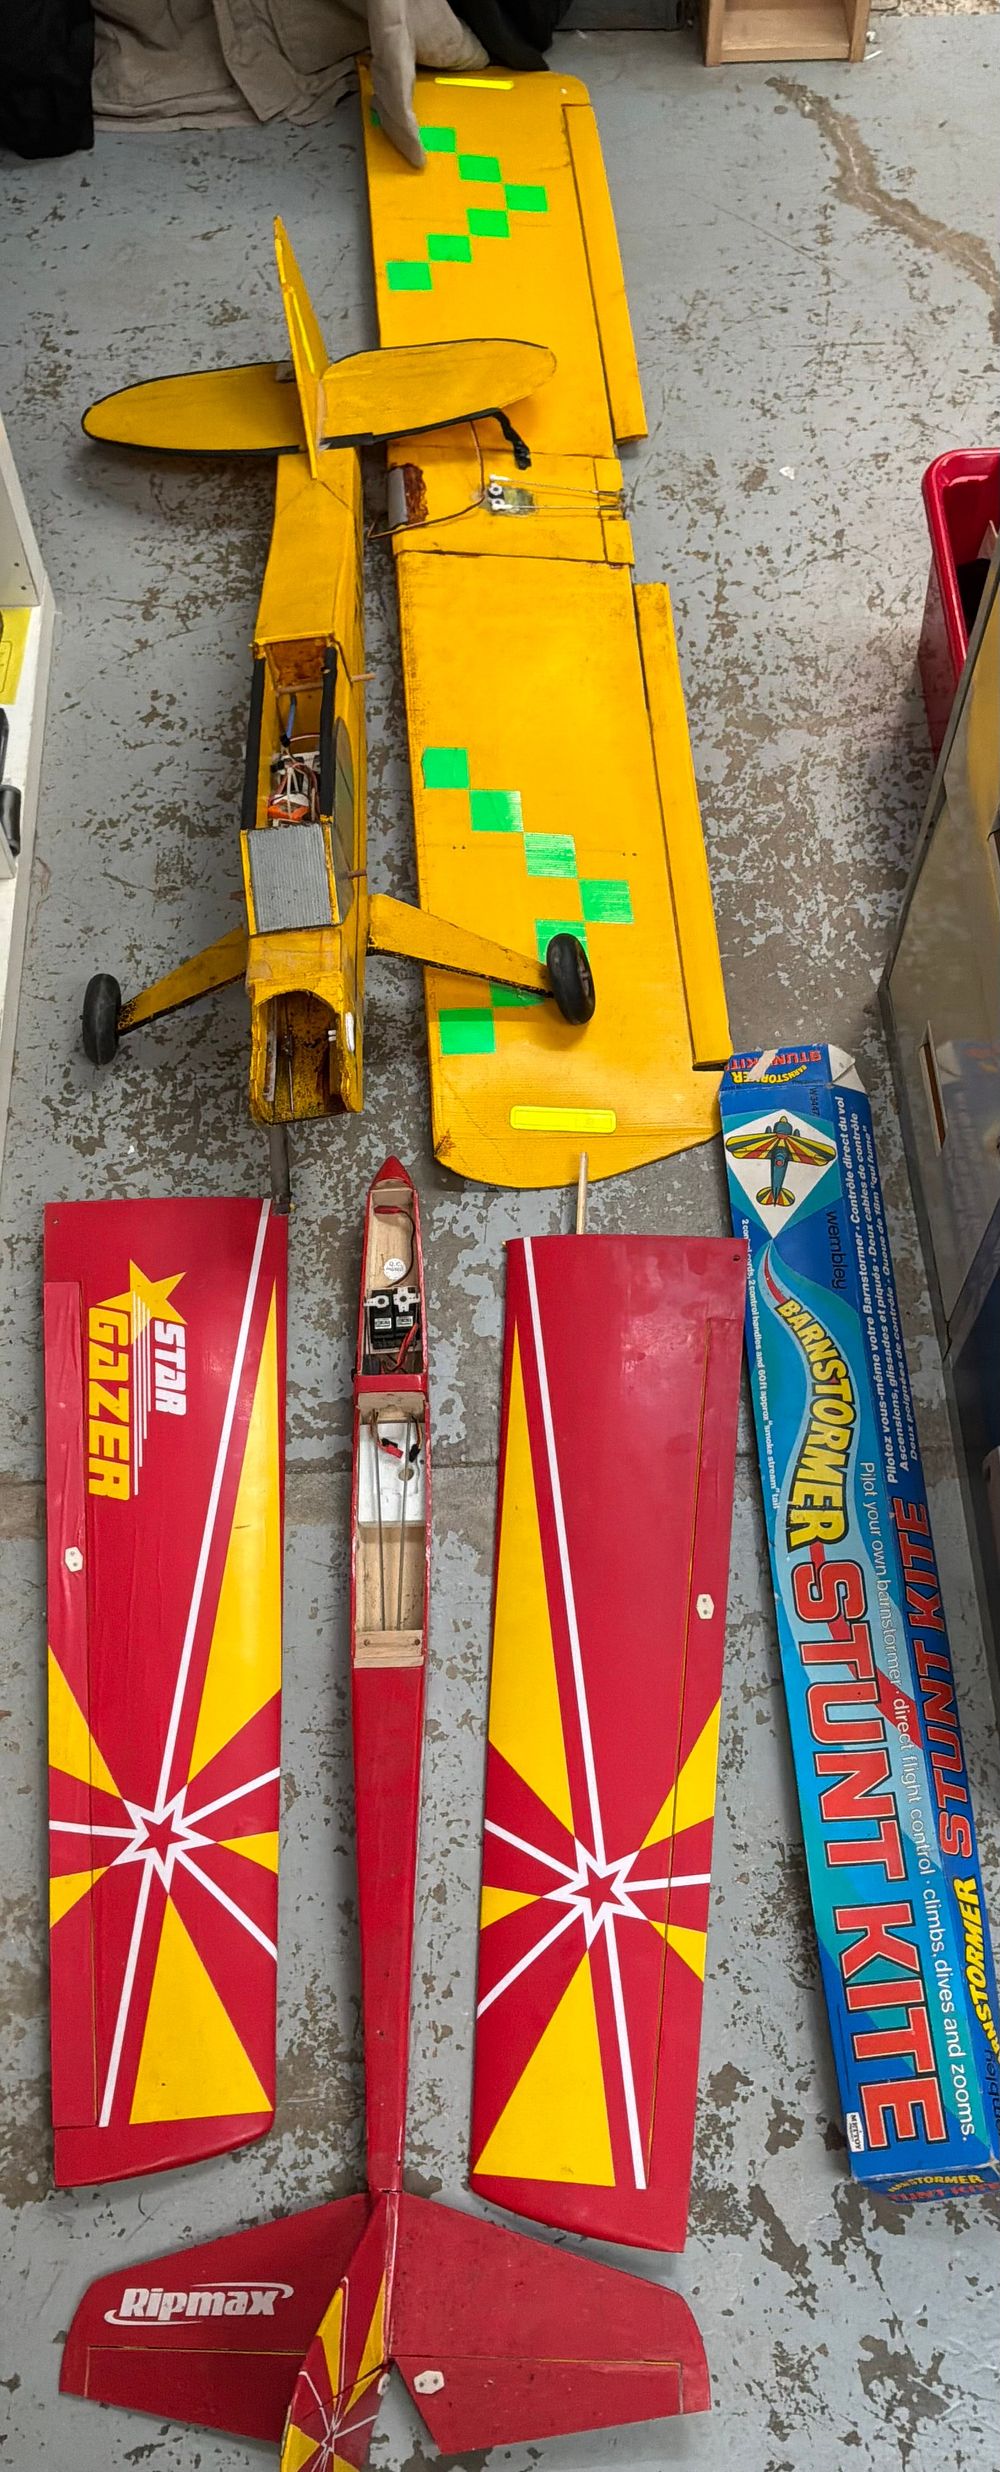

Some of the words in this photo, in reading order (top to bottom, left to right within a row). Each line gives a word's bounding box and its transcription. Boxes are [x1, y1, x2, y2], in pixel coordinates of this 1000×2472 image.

[724, 1058, 760, 1071] KIT
[730, 1064, 808, 1084] BARNSTORER
[771, 1050, 822, 1066] STUN
[835, 1096, 846, 1114] vol
[838, 1118, 848, 1132] du
[840, 1133, 853, 1169] direct
[850, 1113, 864, 1162] contrôle
[858, 1164, 867, 1179] de
[845, 1171, 860, 1224] Contrôle
[861, 1182, 873, 1221] cables
[866, 1224, 878, 1256] Deux
[876, 1218, 885, 1234] de
[826, 1210, 848, 1291] wembley
[880, 1235, 890, 1276] Queue
[855, 1232, 873, 1315] Barnstormer
[872, 1265, 887, 1311] piqués
[749, 1285, 760, 1319] control
[877, 1309, 887, 1323] et
[886, 1286, 900, 1341] contrôle
[752, 1318, 763, 1351] handles
[867, 1317, 880, 1351] votre
[894, 1342, 903, 1359] de
[756, 1351, 765, 1369] and
[881, 1325, 898, 1387] glissades
[760, 1392, 769, 1421] approx
[872, 1354, 890, 1433] vous-même
[900, 1362, 914, 1423] poignées
[774, 1296, 857, 1553] BARNSTORMER
[891, 1389, 910, 1471] Ascensions,
[908, 1427, 918, 1460] Deux
[860, 1462, 878, 1497] Pilot
[884, 1436, 899, 1484] Pilotez
[772, 1493, 780, 1510] tail
[863, 1502, 881, 1537] your
[871, 1538, 887, 1576] own
[892, 1497, 947, 1633] KITE
[877, 1580, 902, 1686] barnstormer
[788, 1560, 908, 1883] STUNT
[893, 1698, 915, 1751] direct
[912, 1638, 973, 1858] STUNT
[901, 1756, 922, 1803] flight
[911, 1809, 936, 1876] control
[923, 1889, 947, 1957] climbs,
[934, 1960, 956, 2013] dives
[833, 1898, 949, 2151] KITE
[944, 2018, 967, 2057] and
[951, 2064, 975, 2142] zooms.
[119, 2287, 279, 2321] Ripmax
